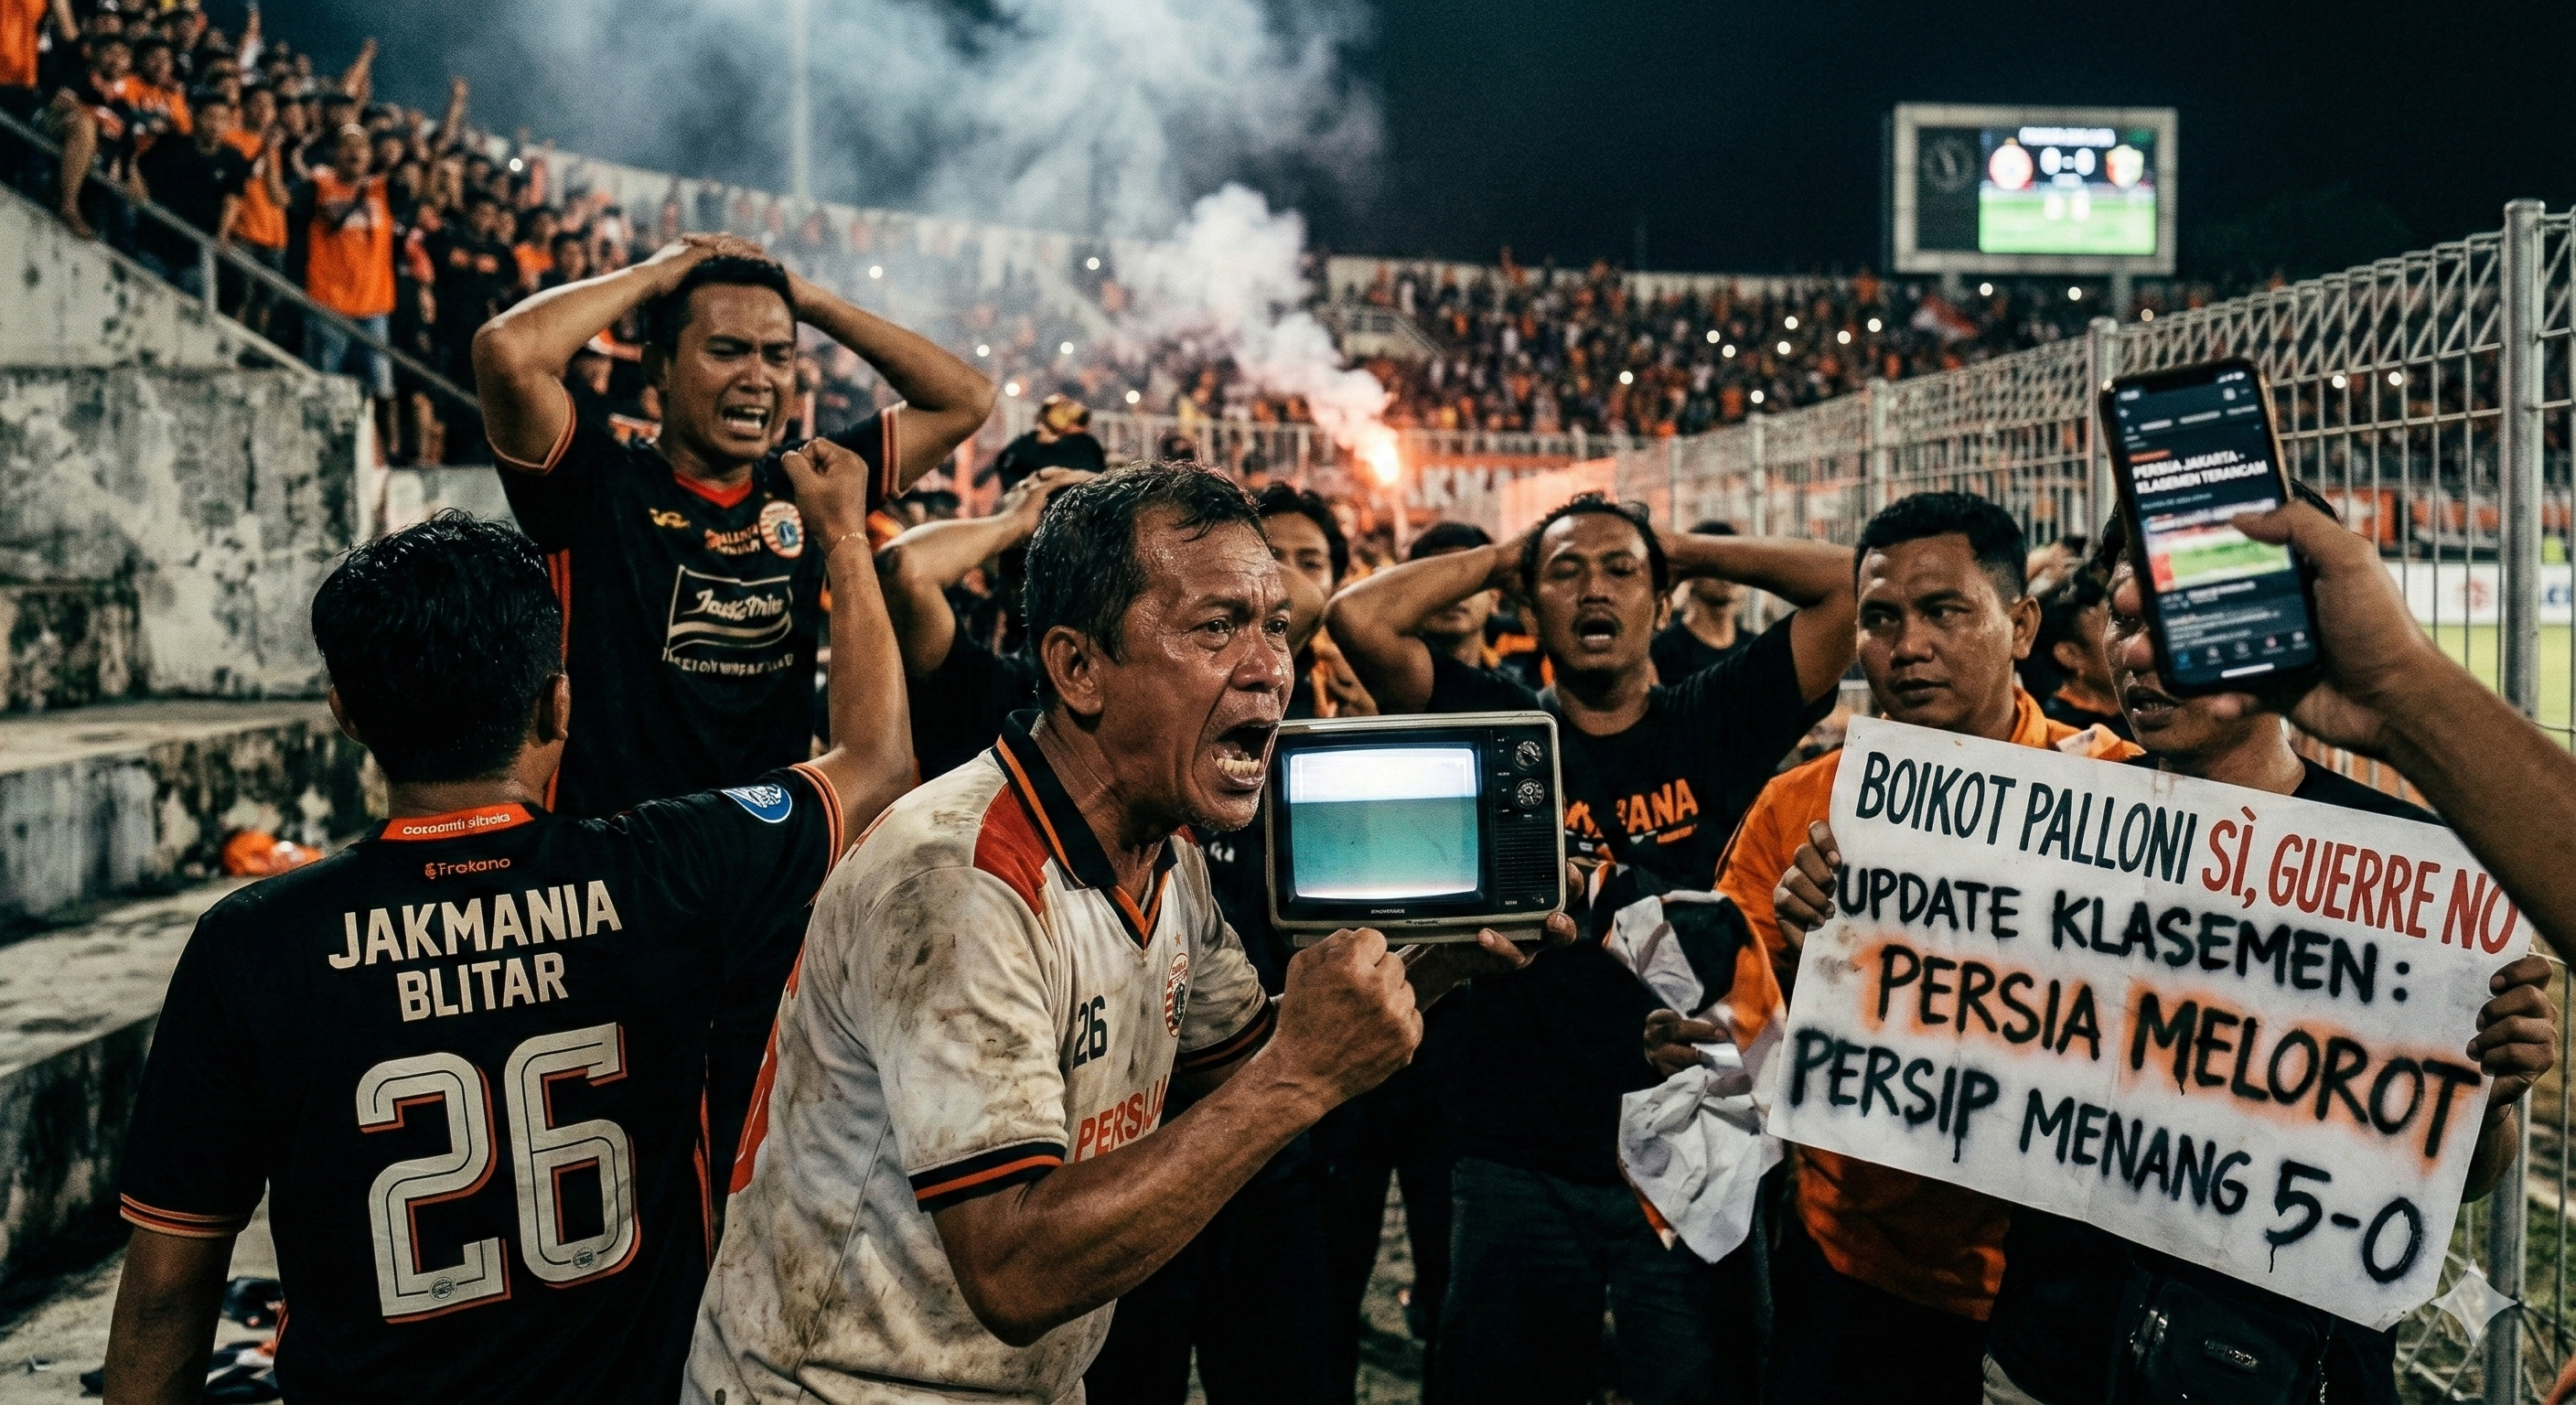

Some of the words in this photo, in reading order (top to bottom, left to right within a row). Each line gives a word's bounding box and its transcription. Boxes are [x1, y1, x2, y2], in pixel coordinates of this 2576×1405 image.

[328, 879, 623, 971] JAKMANIA
[1837, 864, 2021, 939] UPDATE
[1856, 751, 2016, 845] BOIKOT
[2019, 782, 2197, 885] PALLONI
[2202, 806, 2257, 909] SÌ,
[2268, 833, 2442, 939] GUERRE
[2441, 868, 2520, 955] NO
[396, 951, 568, 1023] BLITAR
[1072, 994, 1108, 1070] 26
[1878, 944, 2101, 1062] PERSIA
[2130, 992, 2483, 1160] MELOROT
[356, 1022, 640, 1325] 26
[1788, 1027, 2001, 1154] PERSIP
[2019, 1088, 2252, 1217] MENANG
[2266, 1159, 2424, 1284] 5-0
